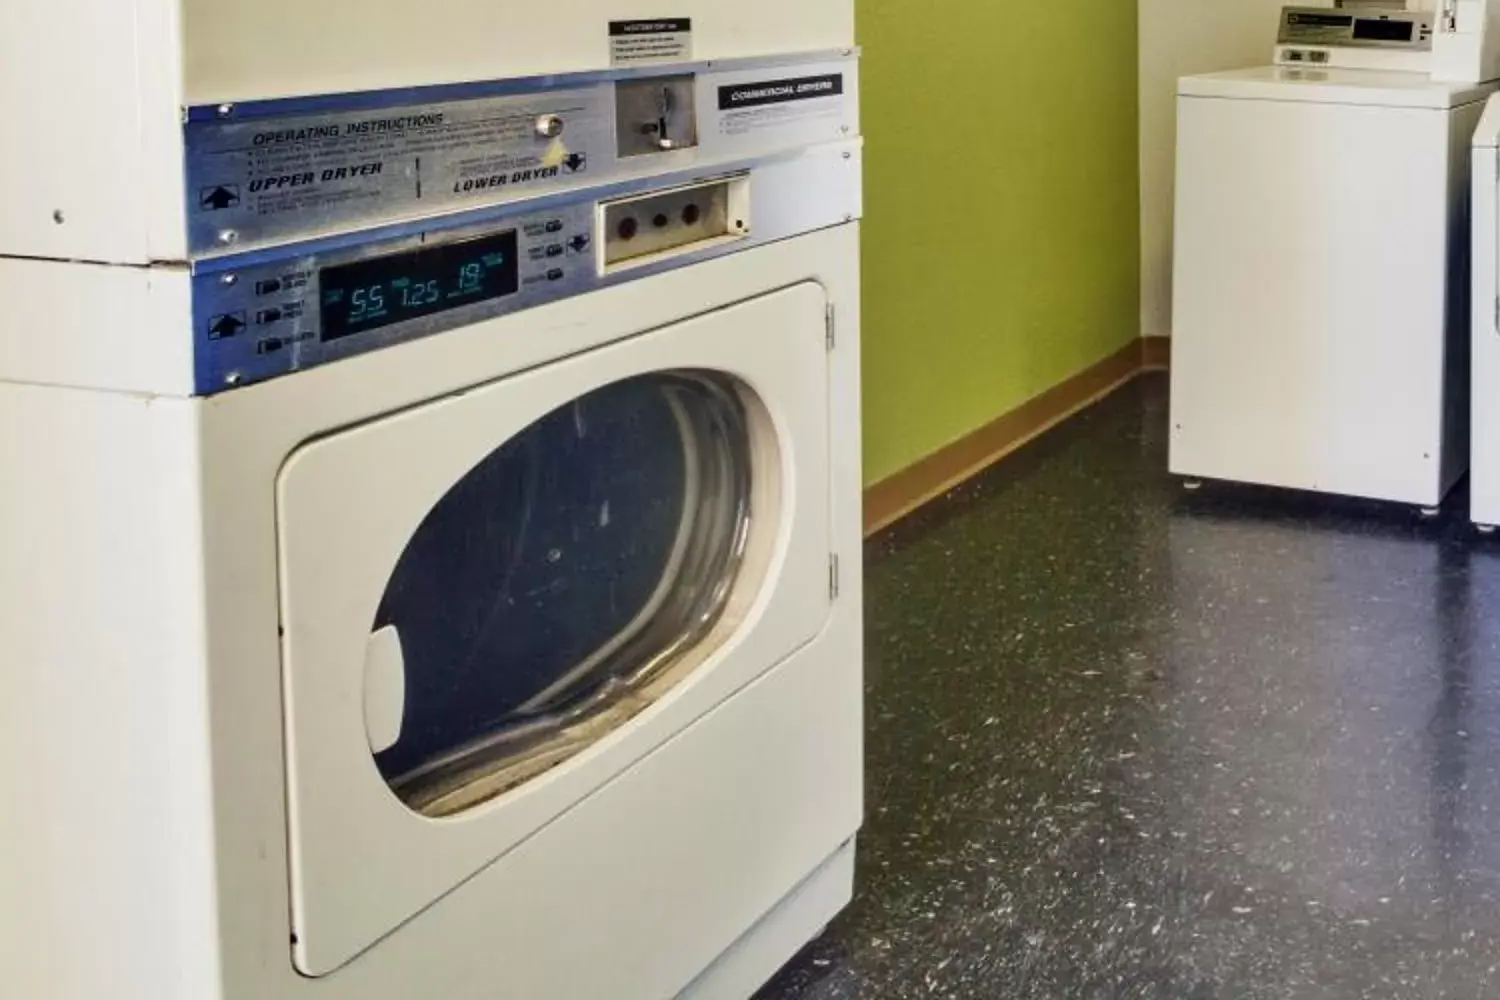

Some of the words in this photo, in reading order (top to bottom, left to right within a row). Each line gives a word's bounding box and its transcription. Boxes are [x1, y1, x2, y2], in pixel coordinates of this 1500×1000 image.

[253, 124, 339, 146] OPERATING
[346, 113, 444, 133] INSTRUCTIONS
[249, 171, 314, 193] UPPER
[320, 162, 383, 182] DRYER
[453, 174, 507, 193] LOWER
[511, 165, 559, 184] DRYER
[351, 285, 384, 315] 55
[402, 280, 439, 307] 1.25
